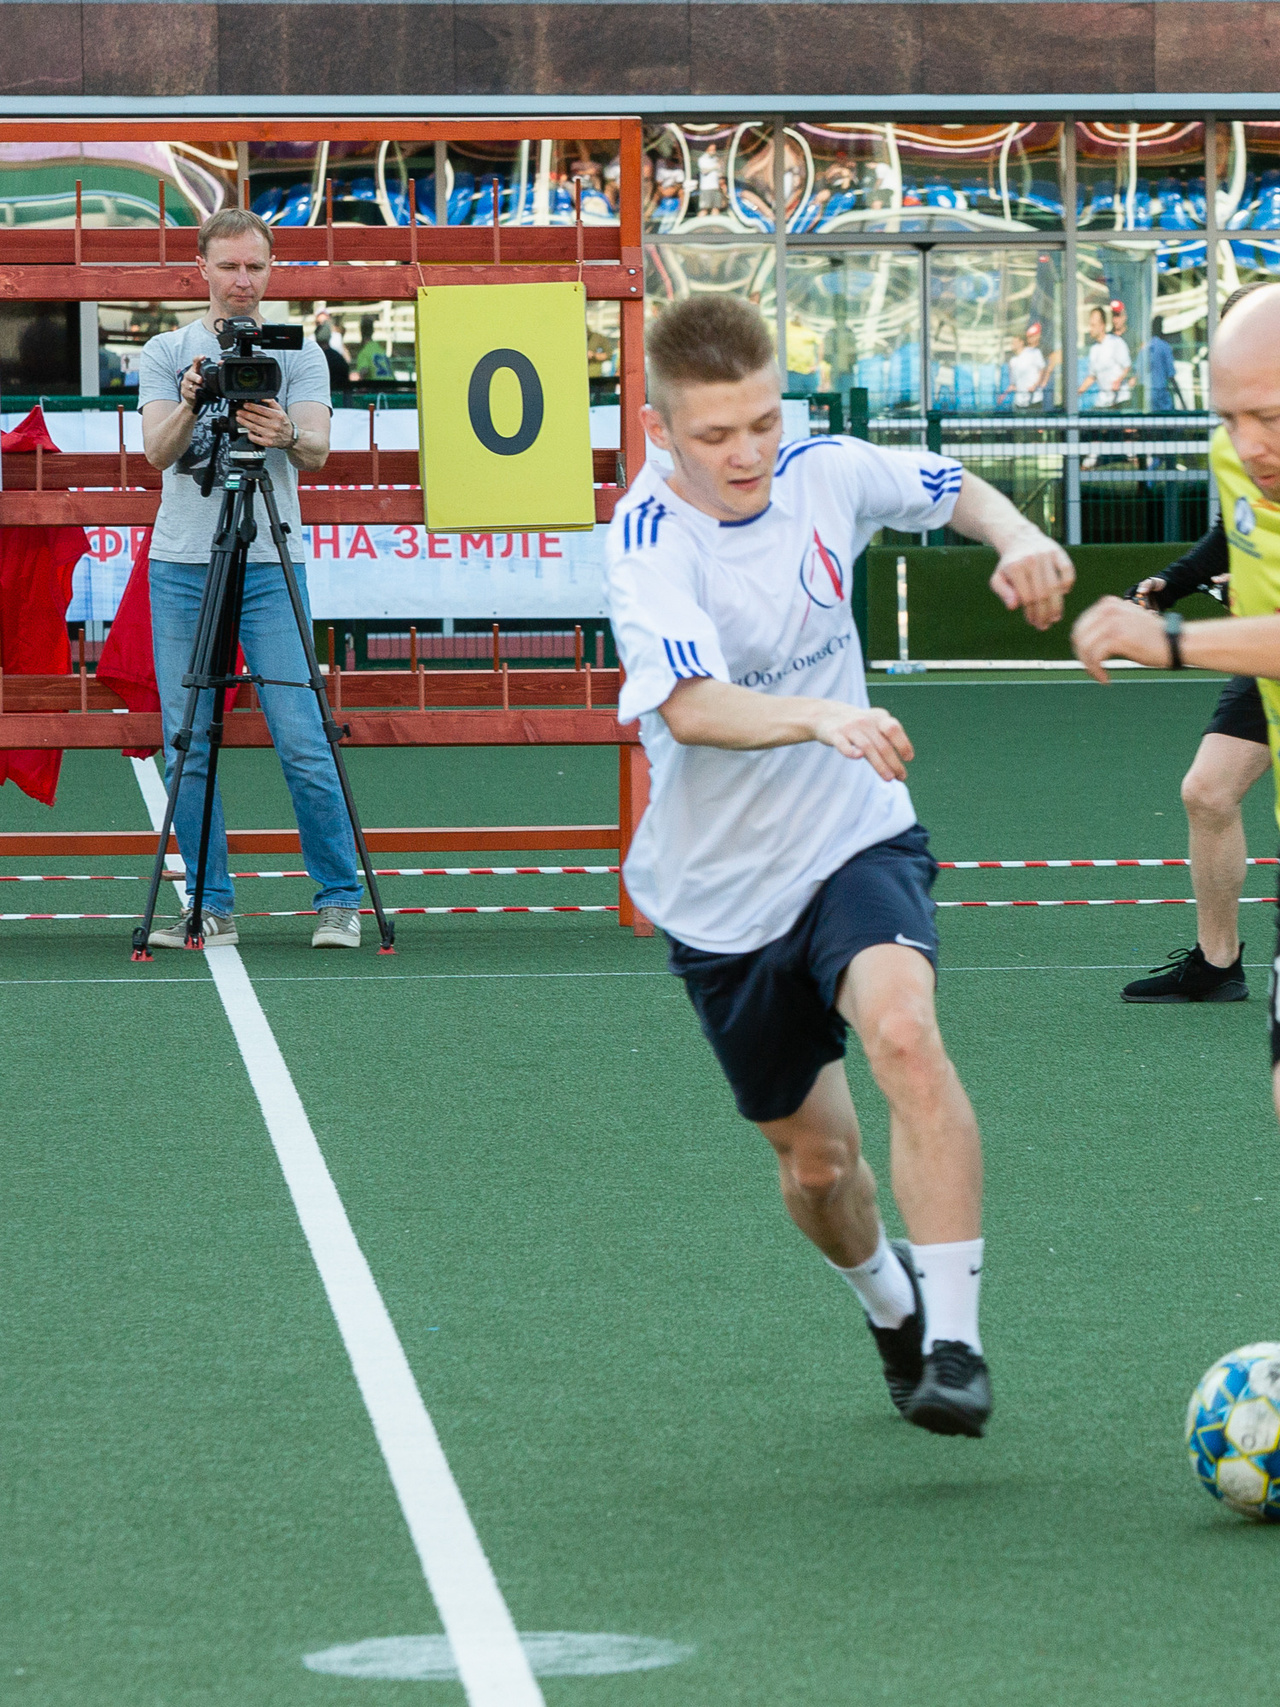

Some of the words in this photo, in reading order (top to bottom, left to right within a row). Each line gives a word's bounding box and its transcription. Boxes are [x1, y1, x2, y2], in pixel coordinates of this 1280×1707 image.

[467, 348, 544, 456] 0
[312, 525, 378, 559] НА
[393, 525, 563, 559] ЗЕМЛЕ
